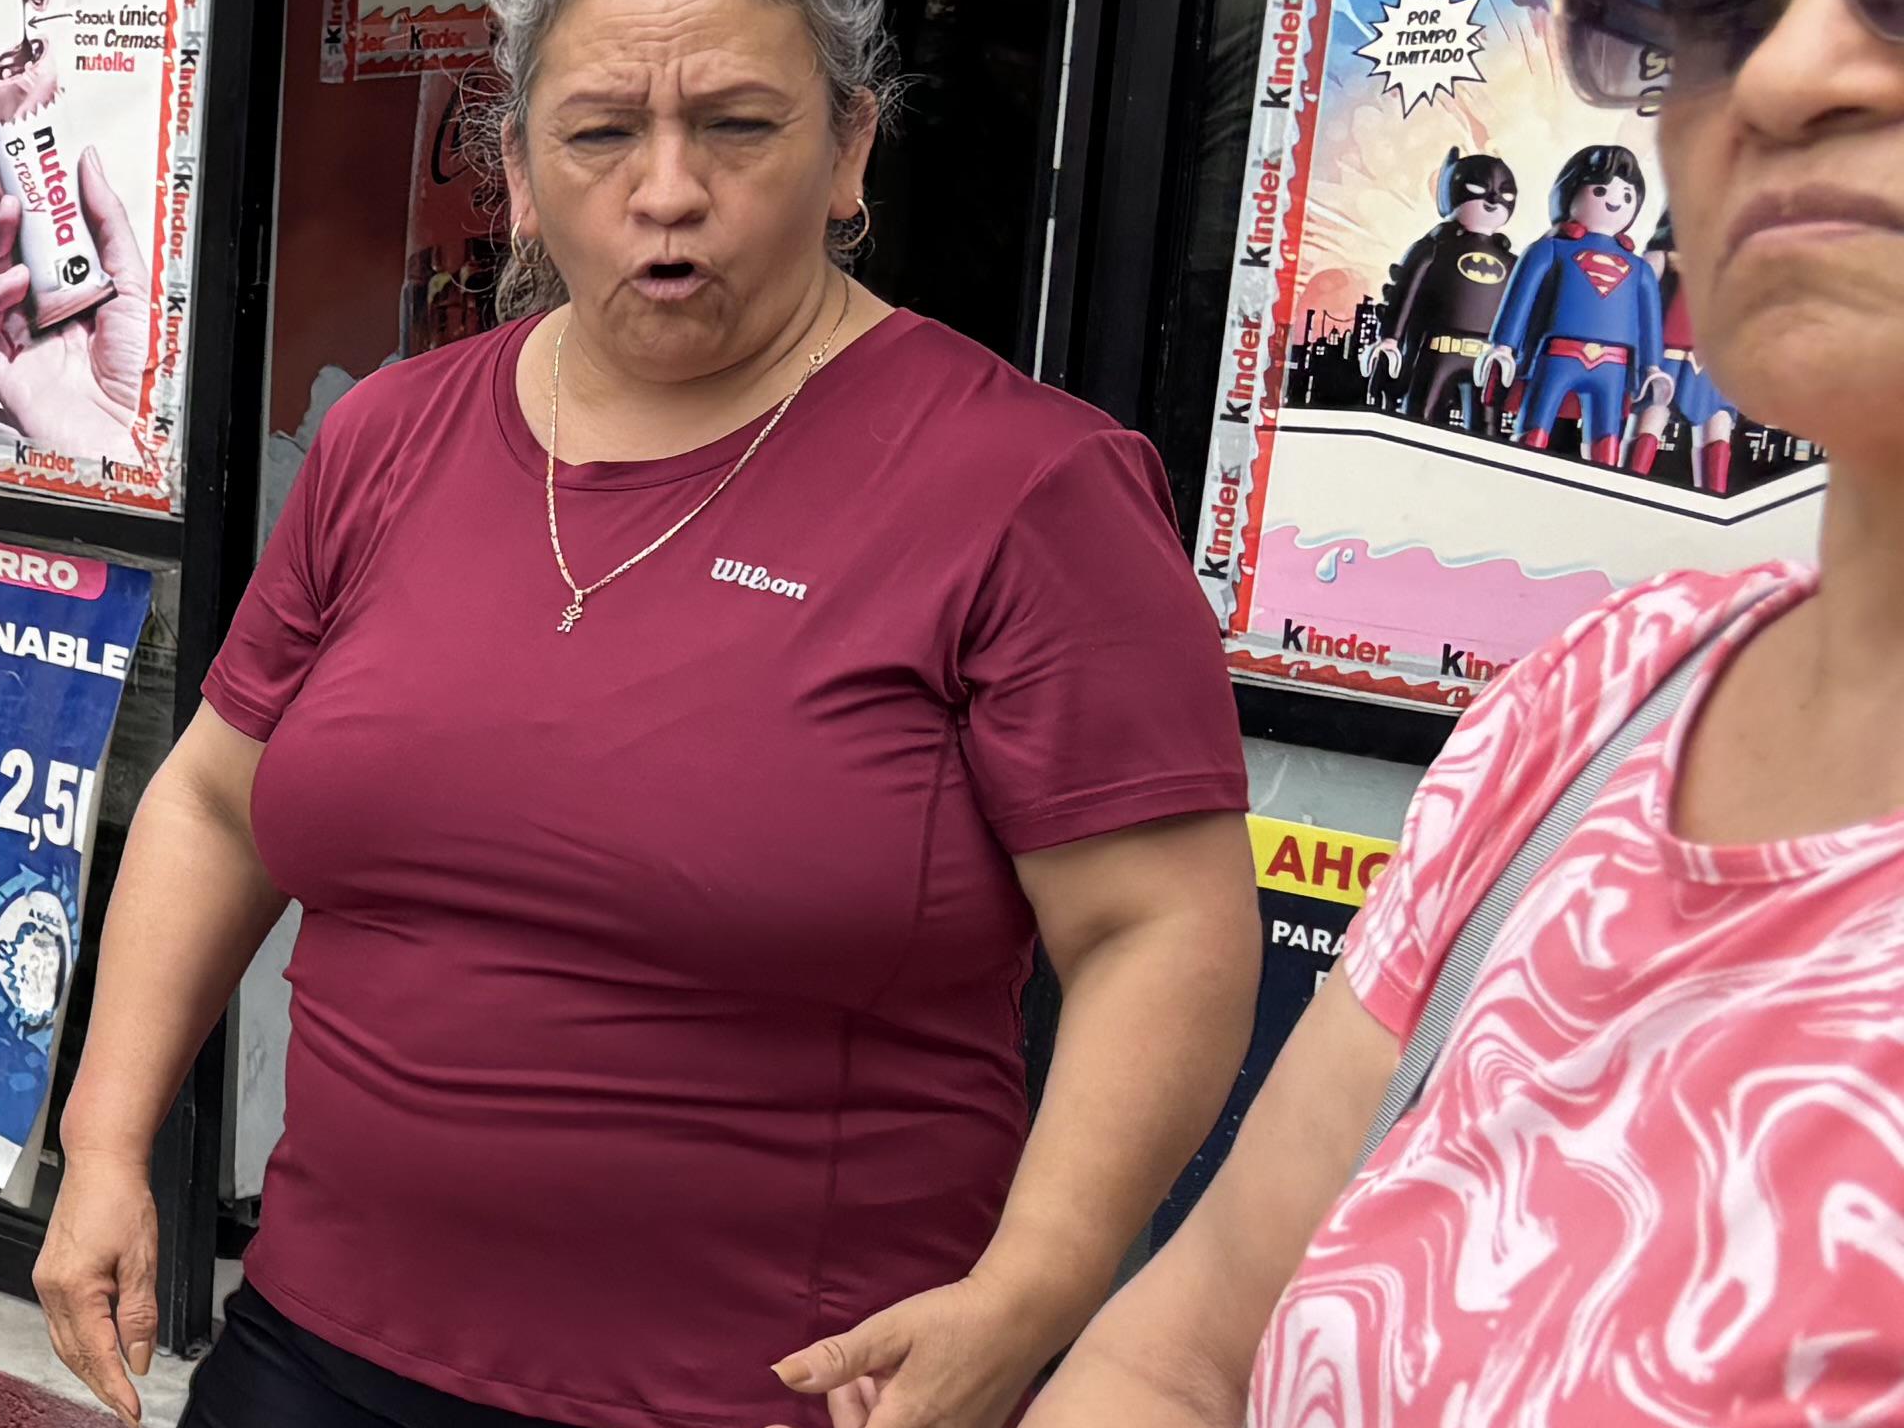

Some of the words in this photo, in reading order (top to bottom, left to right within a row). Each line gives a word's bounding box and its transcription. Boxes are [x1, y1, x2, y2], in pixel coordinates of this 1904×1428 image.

[1407, 9, 1440, 27] POR
[1396, 27, 1457, 47] TIEMPO
[1385, 46, 1464, 67] LIMITADO
[33, 125, 77, 248] nutella
[710, 557, 808, 601] Wilson
[1281, 618, 1391, 667] Kinder
